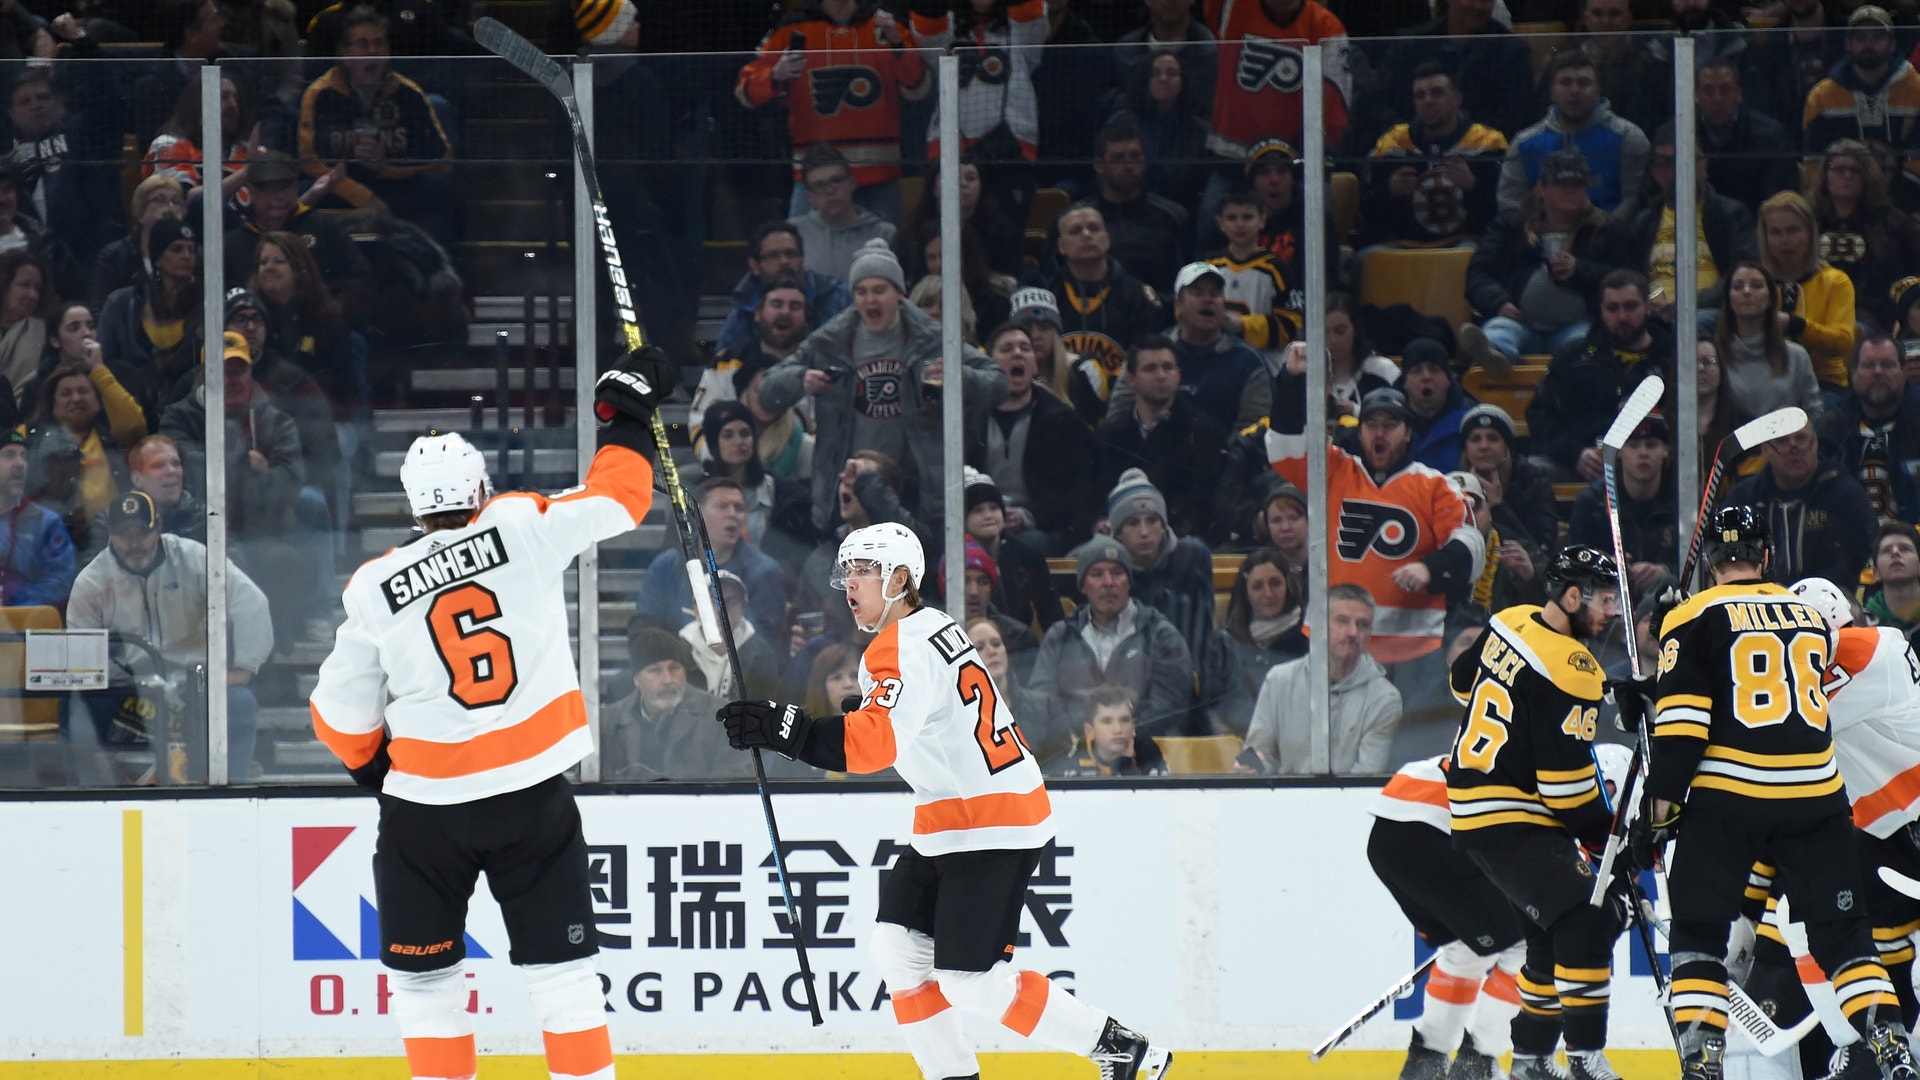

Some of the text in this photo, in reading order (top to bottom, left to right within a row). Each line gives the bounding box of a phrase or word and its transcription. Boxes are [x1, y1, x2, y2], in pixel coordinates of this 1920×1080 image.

[433, 488, 444, 504] 6
[389, 533, 501, 606] SANHEIM
[1724, 602, 1827, 632] MILLER
[424, 580, 519, 711] 6
[859, 677, 904, 710] 23
[1729, 631, 1829, 732] 86
[957, 660, 1033, 776] 2
[1450, 677, 1514, 775] 6
[1561, 704, 1599, 742] 46
[389, 940, 453, 956] BAUER
